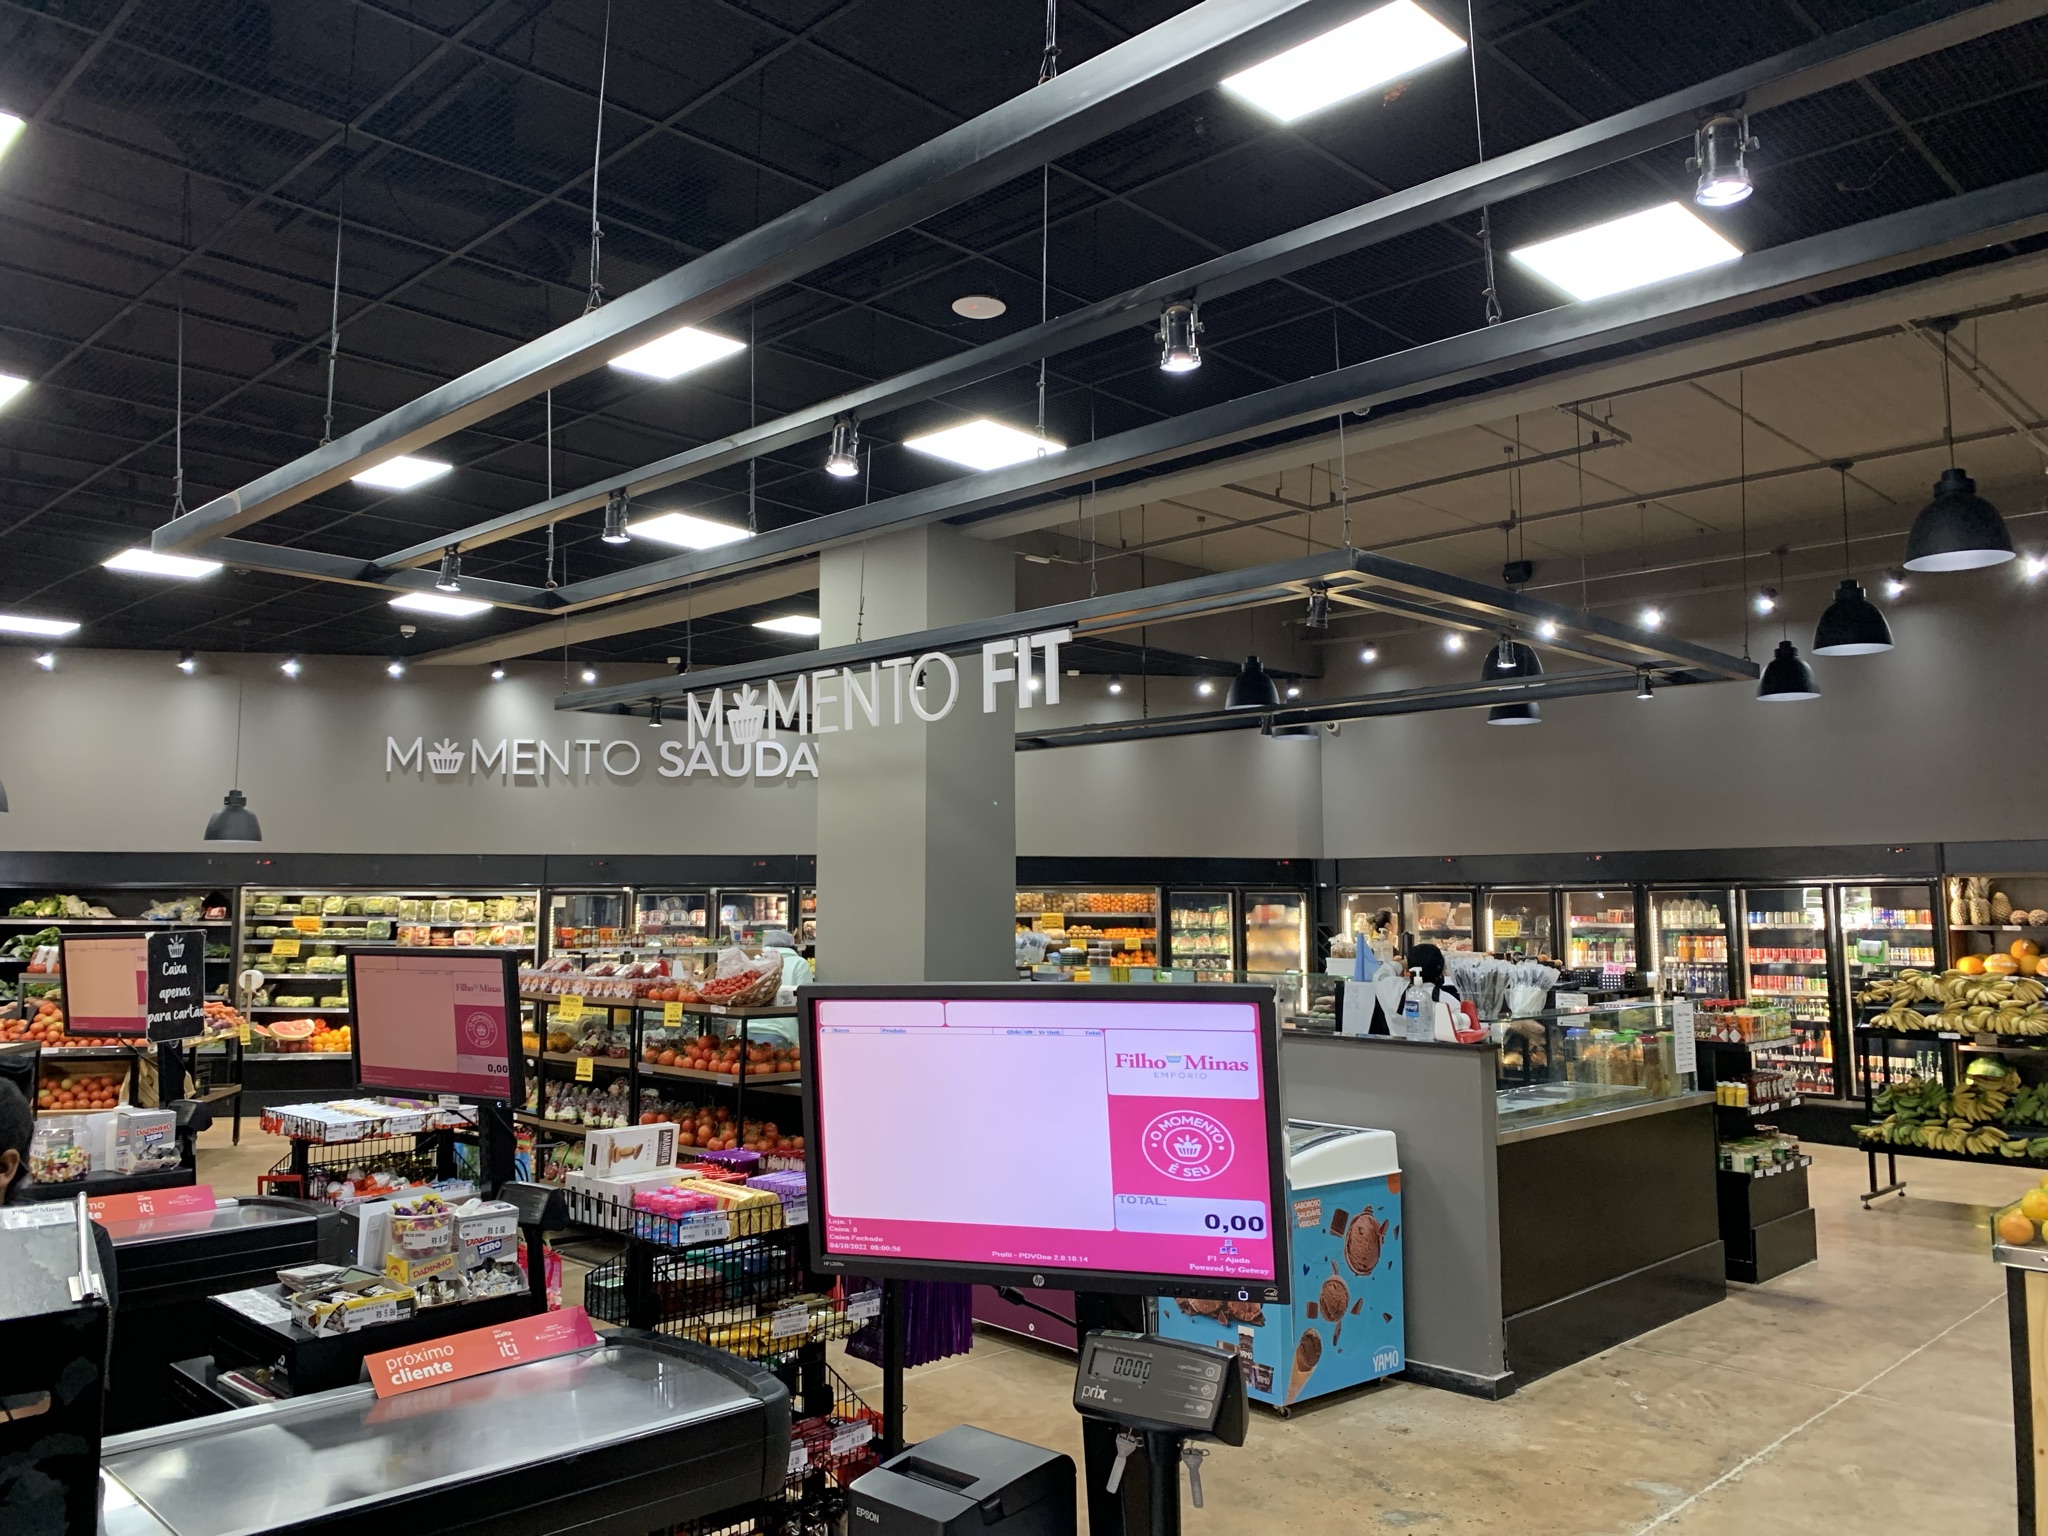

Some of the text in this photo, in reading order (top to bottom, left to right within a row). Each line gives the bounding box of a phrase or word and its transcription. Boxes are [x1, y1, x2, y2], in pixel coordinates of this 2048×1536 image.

[982, 629, 1073, 714] FIT
[658, 740, 819, 778] SAUDA
[162, 961, 188, 975] Caixa
[159, 986, 191, 1004] apenas
[456, 983, 502, 993] Filho Minas
[147, 1003, 204, 1029] para cartão
[487, 1063, 508, 1074] 0,00
[1115, 1052, 1249, 1072] Filho Minas
[1153, 1071, 1208, 1080] EMPÓRIO
[136, 1123, 173, 1136] DADINHO
[1150, 1115, 1225, 1143] O MOMENTO
[145, 1133, 163, 1142] ZERO
[1167, 1162, 1211, 1178] É SEU
[139, 1202, 154, 1213] iti
[1118, 1195, 1168, 1206] TOTAL:
[1204, 1213, 1264, 1233] 0,00
[851, 1234, 884, 1242] Fechado
[478, 1240, 501, 1255] ZERO
[829, 1242, 867, 1250] 04/10/2022
[992, 1250, 1013, 1258] Profit
[1225, 1256, 1251, 1264] Ajuda
[412, 1257, 452, 1280] DADINHO
[1189, 1263, 1224, 1272] Powered
[1225, 1265, 1236, 1274] by
[494, 1330, 513, 1339] aceita
[497, 1338, 519, 1358] iti
[385, 1343, 454, 1373] próximo
[1372, 1349, 1399, 1373] YAMO
[391, 1360, 453, 1386] cliente
[1081, 1384, 1108, 1401] prix
[856, 1506, 880, 1524] EPSON
